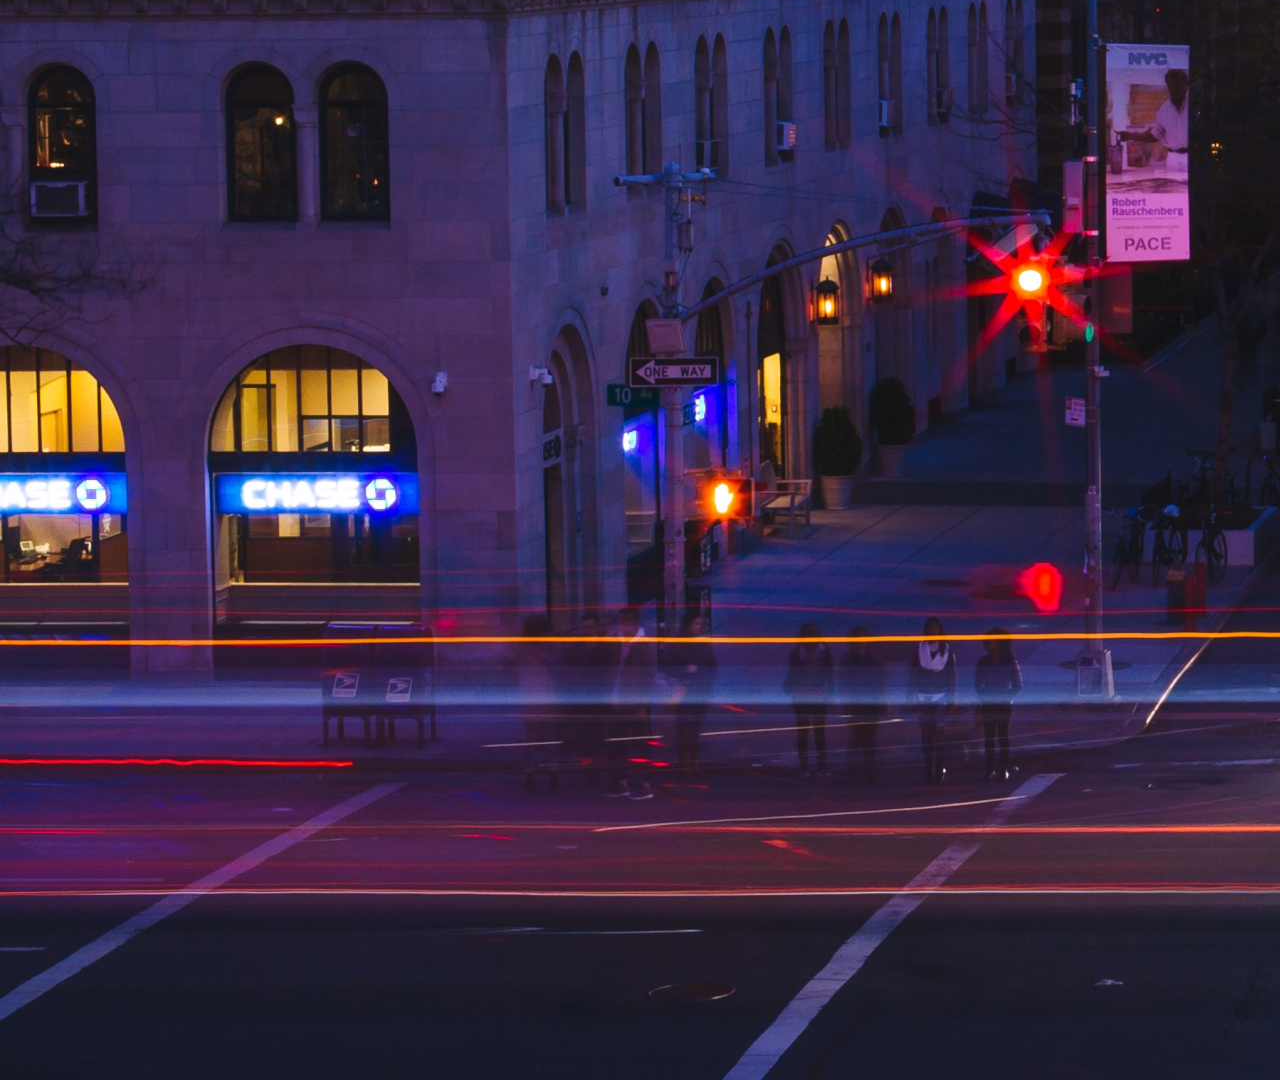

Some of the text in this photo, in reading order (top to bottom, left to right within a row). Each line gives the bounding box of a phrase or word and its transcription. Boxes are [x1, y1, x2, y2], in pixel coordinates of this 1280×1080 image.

[1128, 52, 1168, 66] NYC
[1112, 198, 1146, 207] Robert
[1112, 207, 1184, 217] Rauschenberg
[1124, 236, 1172, 251] PACE
[644, 366, 706, 378] ONE WAY
[614, 387, 632, 404] 10
[0, 481, 72, 510] ASE
[241, 479, 361, 510] CHASE
